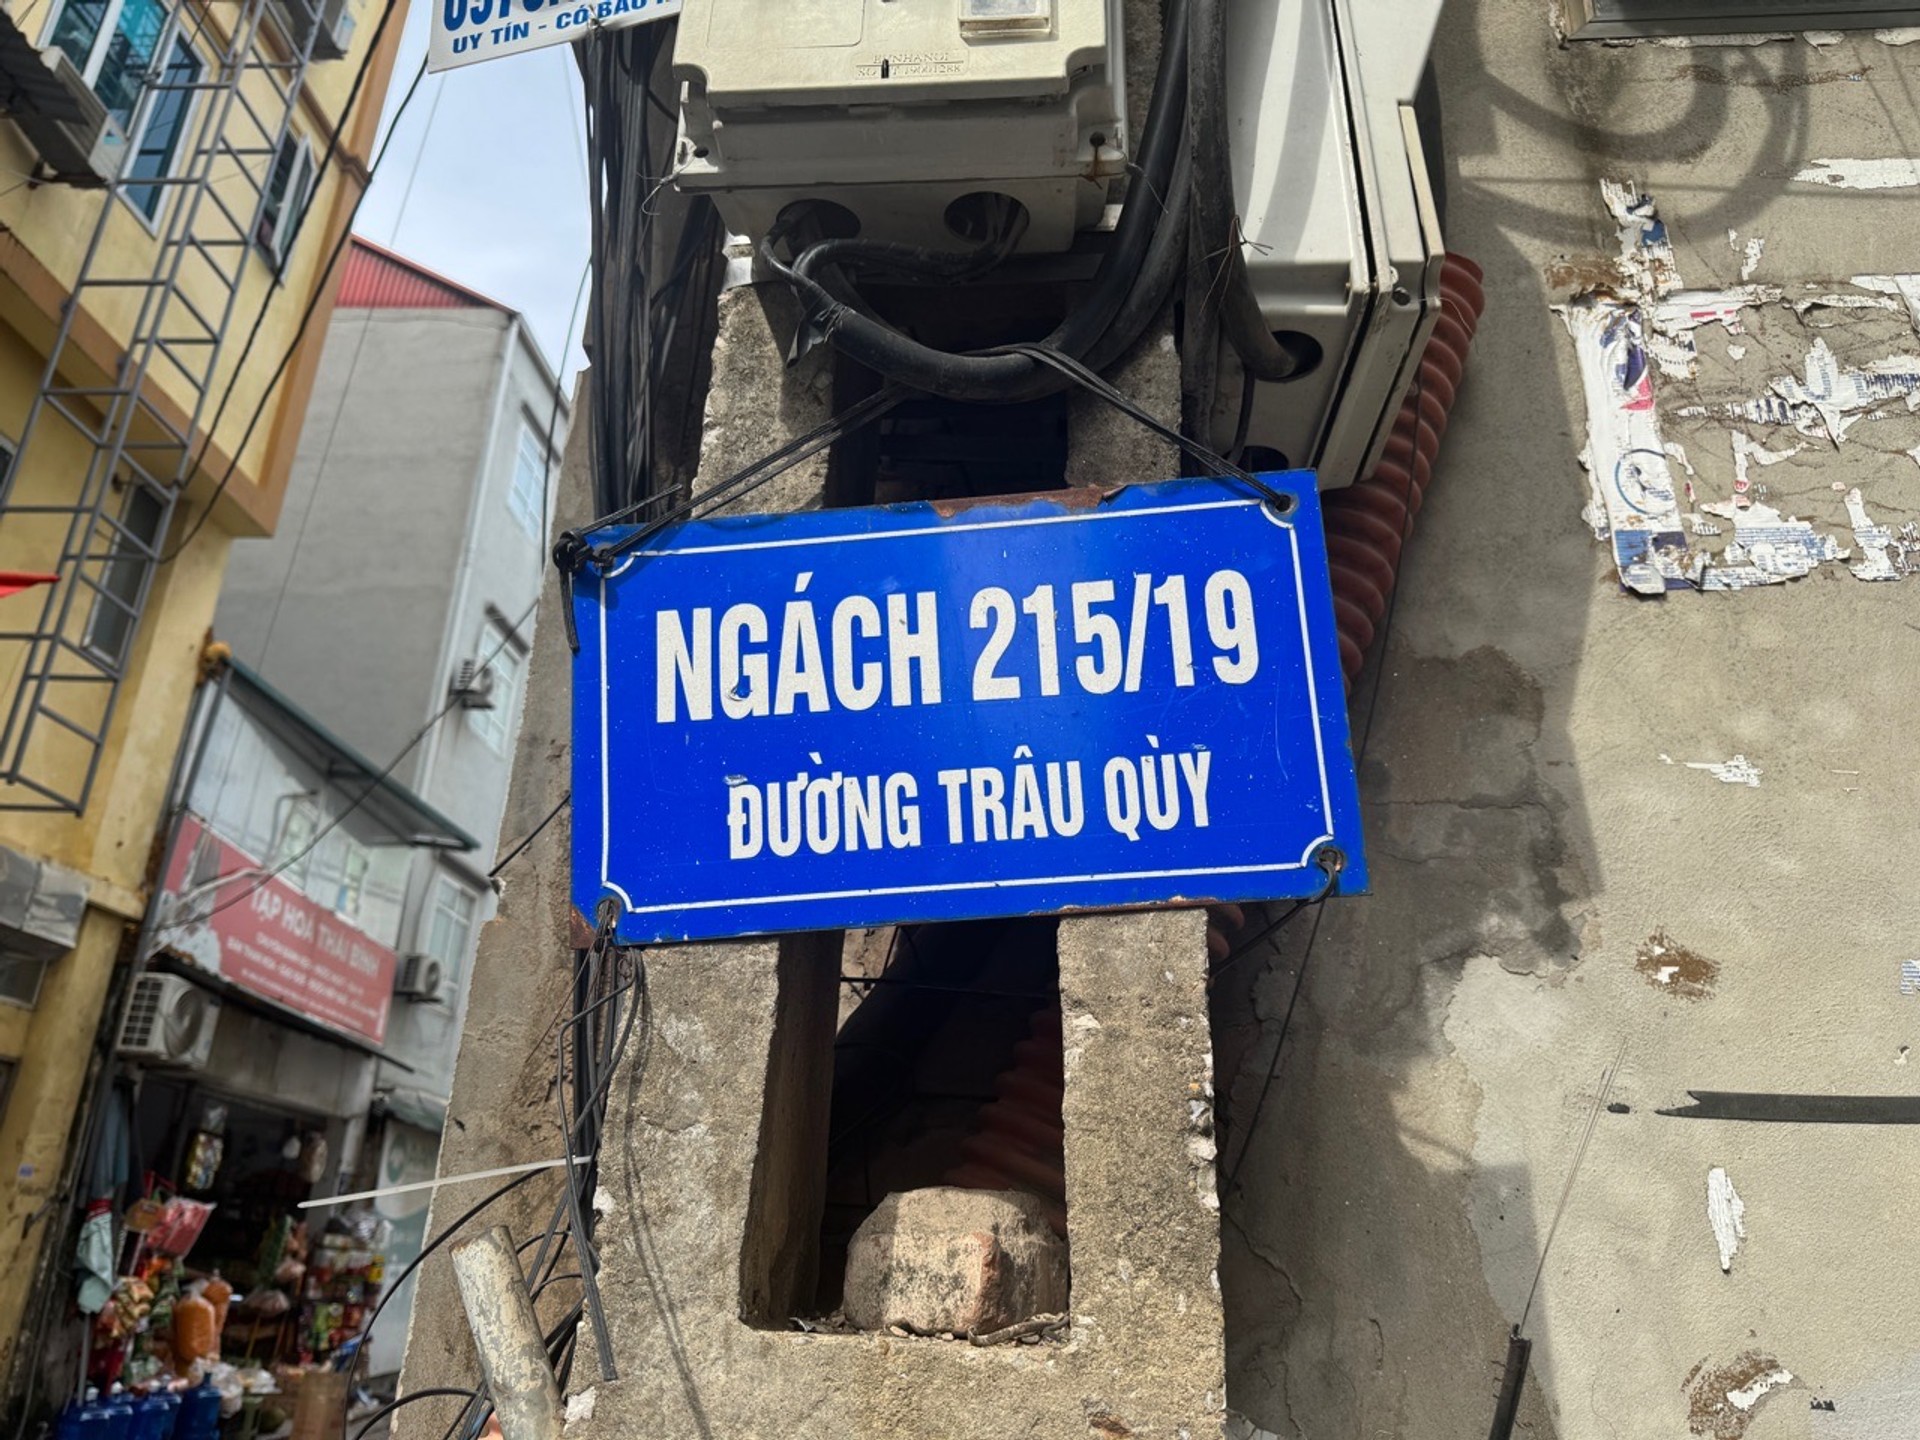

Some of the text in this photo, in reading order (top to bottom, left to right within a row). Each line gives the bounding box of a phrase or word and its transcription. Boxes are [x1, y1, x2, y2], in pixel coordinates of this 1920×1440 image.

[453, 32, 483, 53] UY
[491, 21, 529, 45] TÍN
[556, 4, 590, 30] CÓ
[656, 569, 1260, 723] NGÁCH 215/19
[727, 735, 1211, 859] ĐƯỜNG TRÂU QÙY
